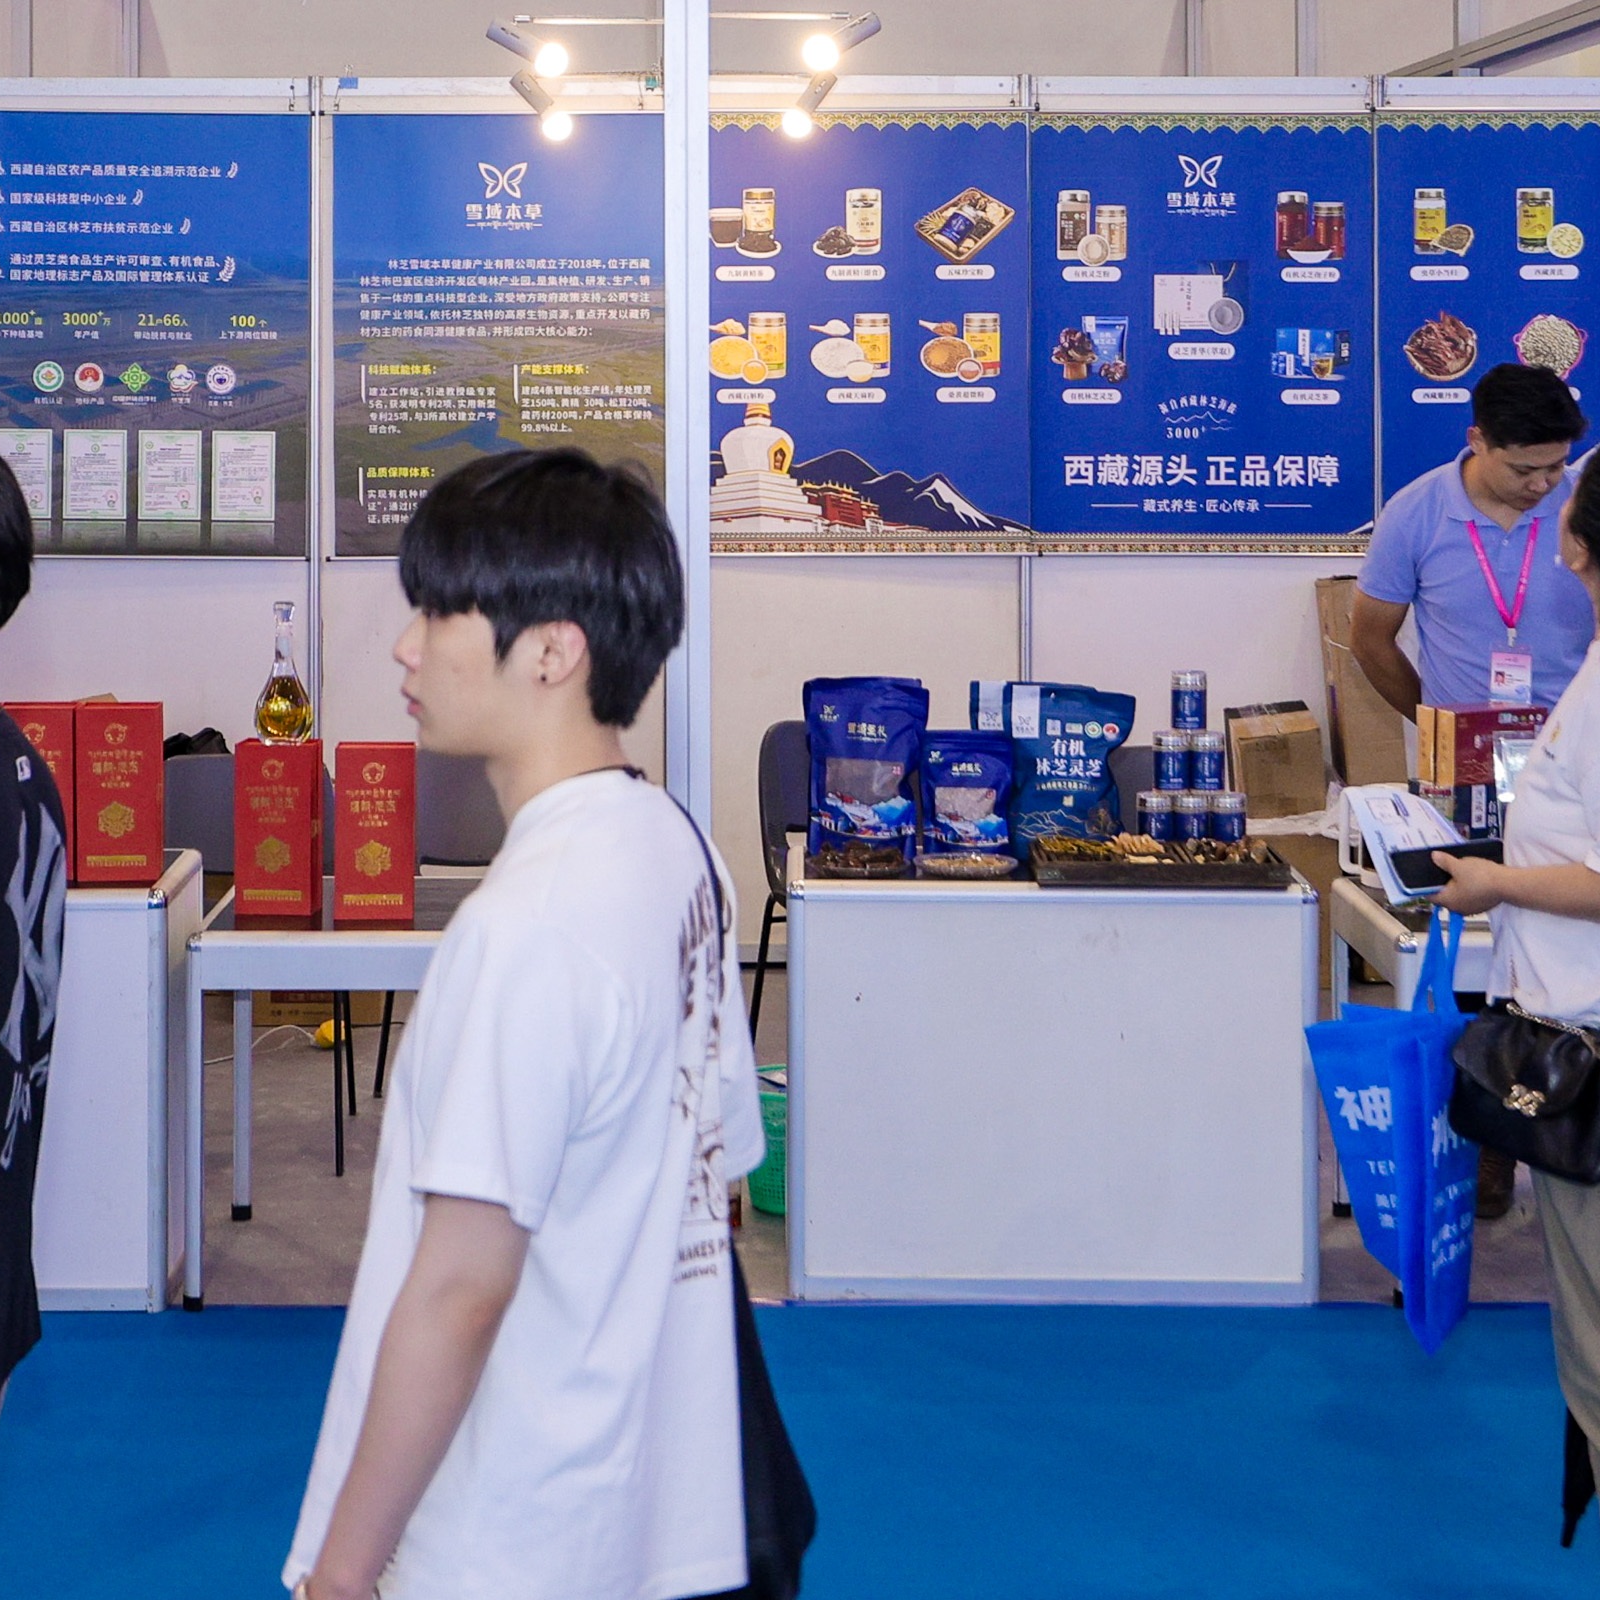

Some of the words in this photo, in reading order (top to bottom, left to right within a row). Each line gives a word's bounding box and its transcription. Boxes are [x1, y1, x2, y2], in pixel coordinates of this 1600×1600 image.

[10, 193, 127, 206] 国家级科技型中小企业
[1166, 192, 1237, 208] 雪域本草
[466, 203, 543, 221] 雪域本草
[9, 220, 174, 235] 西藏自治区林芝市扶贫示范企业
[1063, 453, 1198, 488] 西藏源头
[1205, 453, 1341, 488] 正品保障
[1051, 738, 1087, 757] 有机
[1035, 757, 1103, 779] 林芝灵芝
